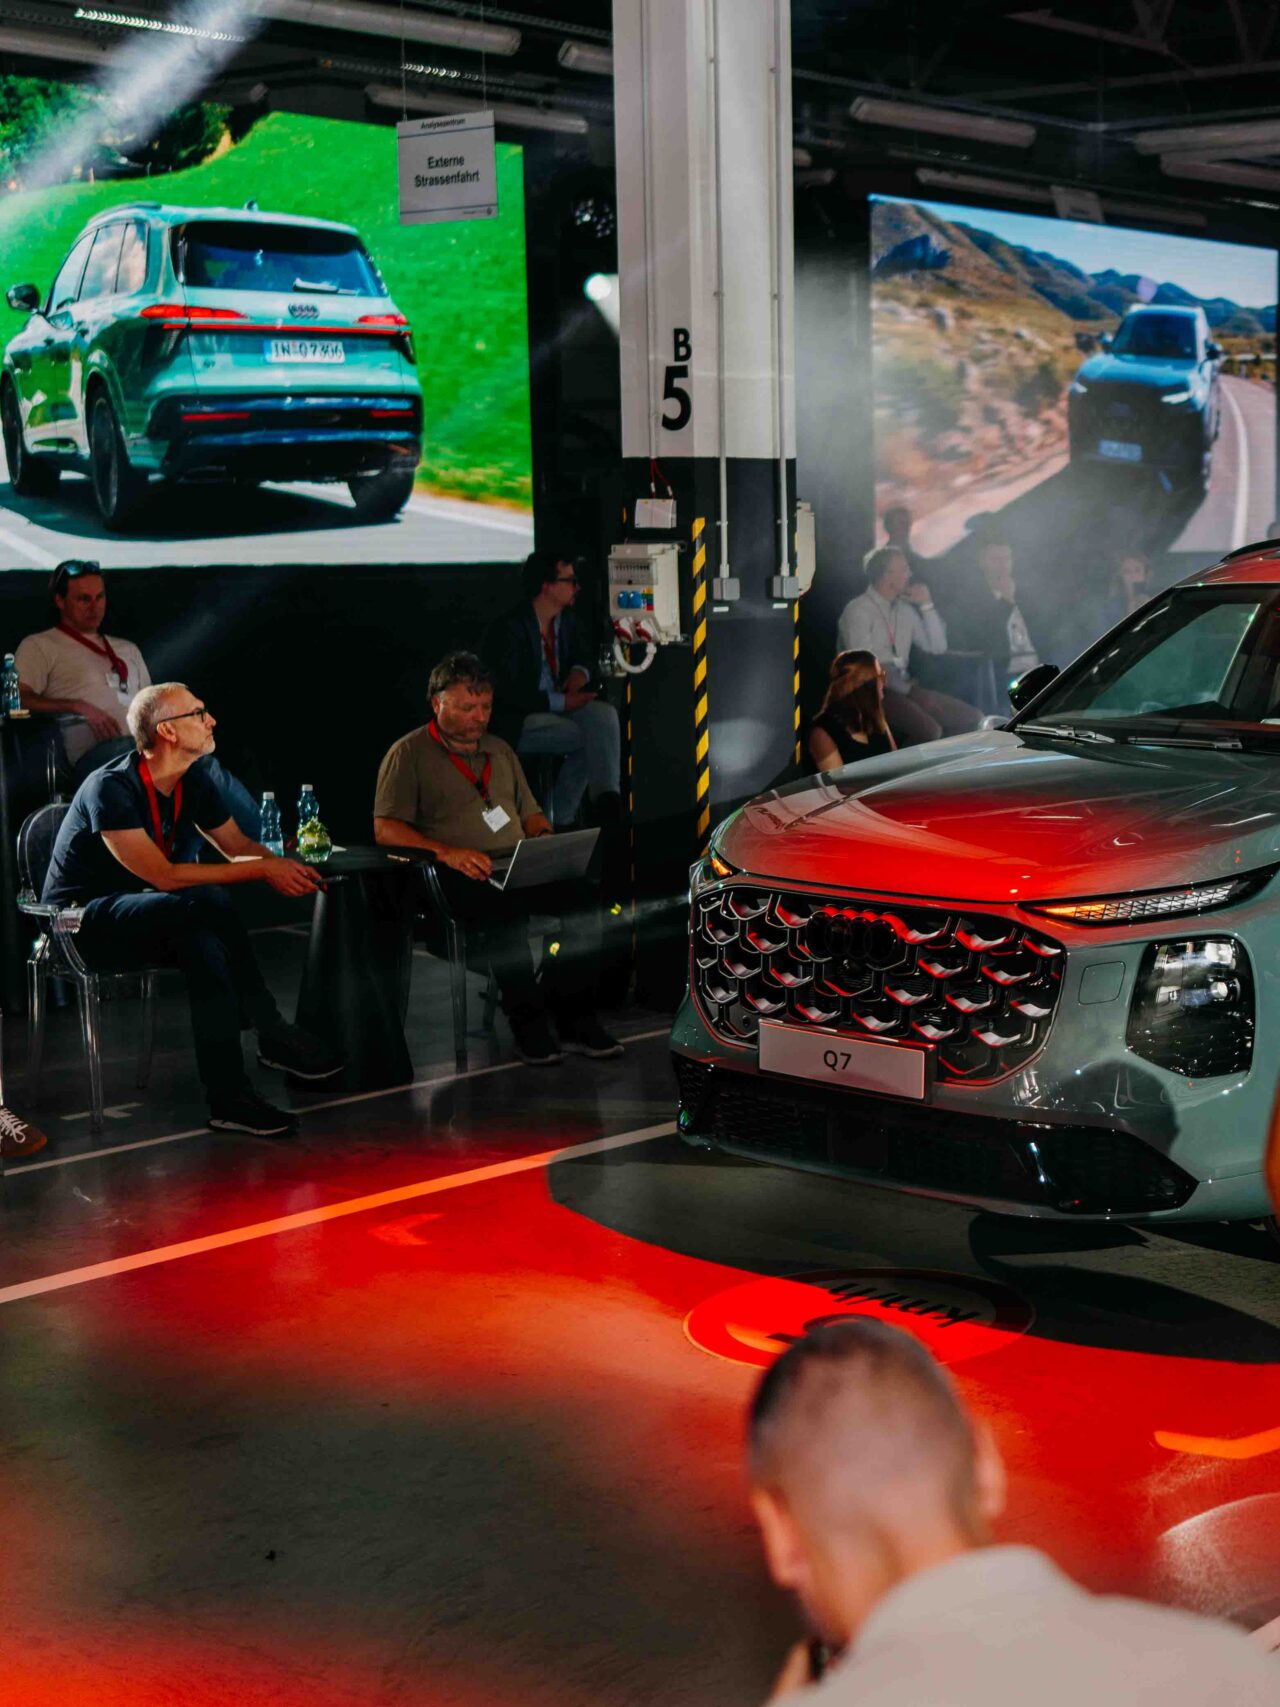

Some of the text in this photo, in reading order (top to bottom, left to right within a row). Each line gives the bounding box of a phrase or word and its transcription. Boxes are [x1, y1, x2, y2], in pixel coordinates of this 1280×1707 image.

[428, 155, 465, 170] Externe
[414, 169, 480, 188] Strassenfahrt
[673, 328, 692, 362] B
[661, 365, 692, 431] 5
[823, 1050, 852, 1072] Q7
[827, 1283, 982, 1328] km/h
